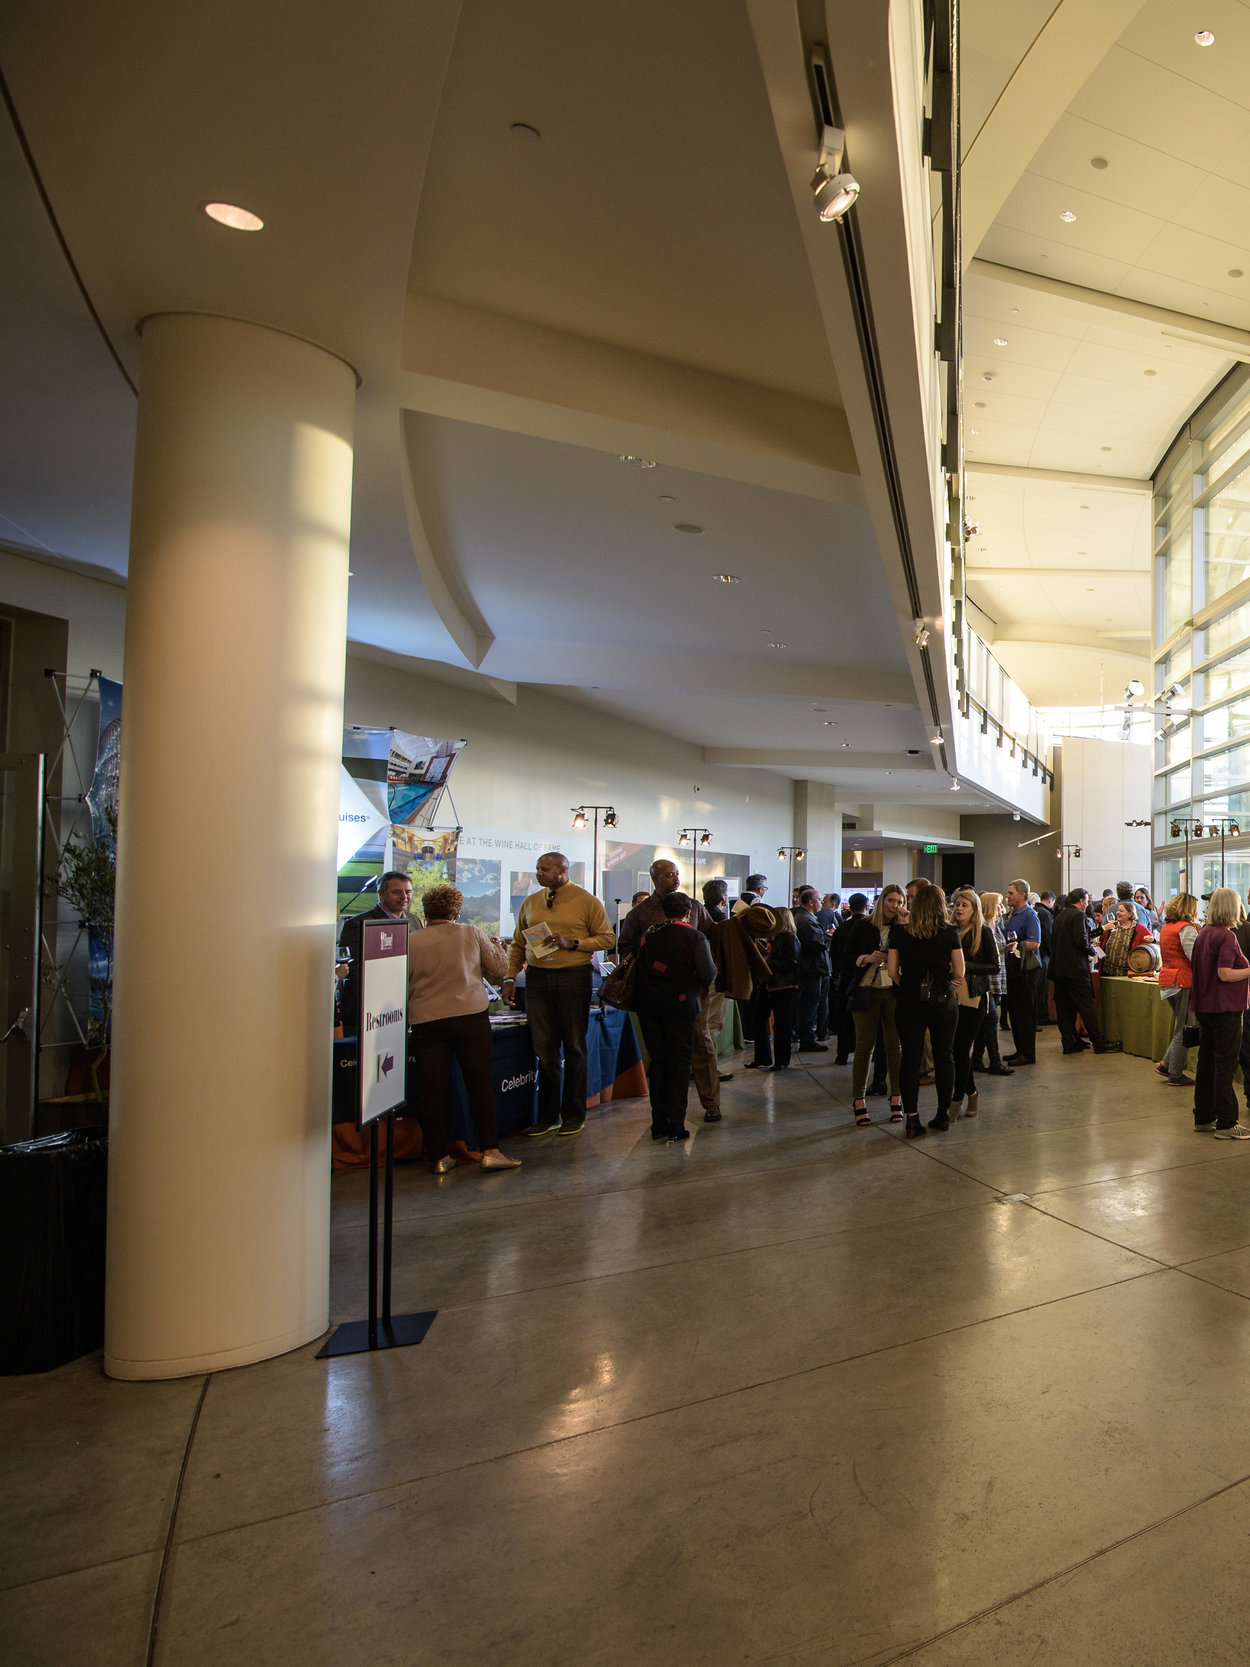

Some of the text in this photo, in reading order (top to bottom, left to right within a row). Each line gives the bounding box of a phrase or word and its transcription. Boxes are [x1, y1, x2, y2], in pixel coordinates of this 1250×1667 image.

[466, 837, 476, 846] AT
[478, 838, 492, 847] THE
[494, 839, 513, 849] WINE
[515, 841, 532, 851] HALL
[533, 842, 542, 852] OF
[544, 843, 561, 852] FAME
[366, 1008, 404, 1032] Restrooms
[501, 1069, 539, 1093] Celebrity
